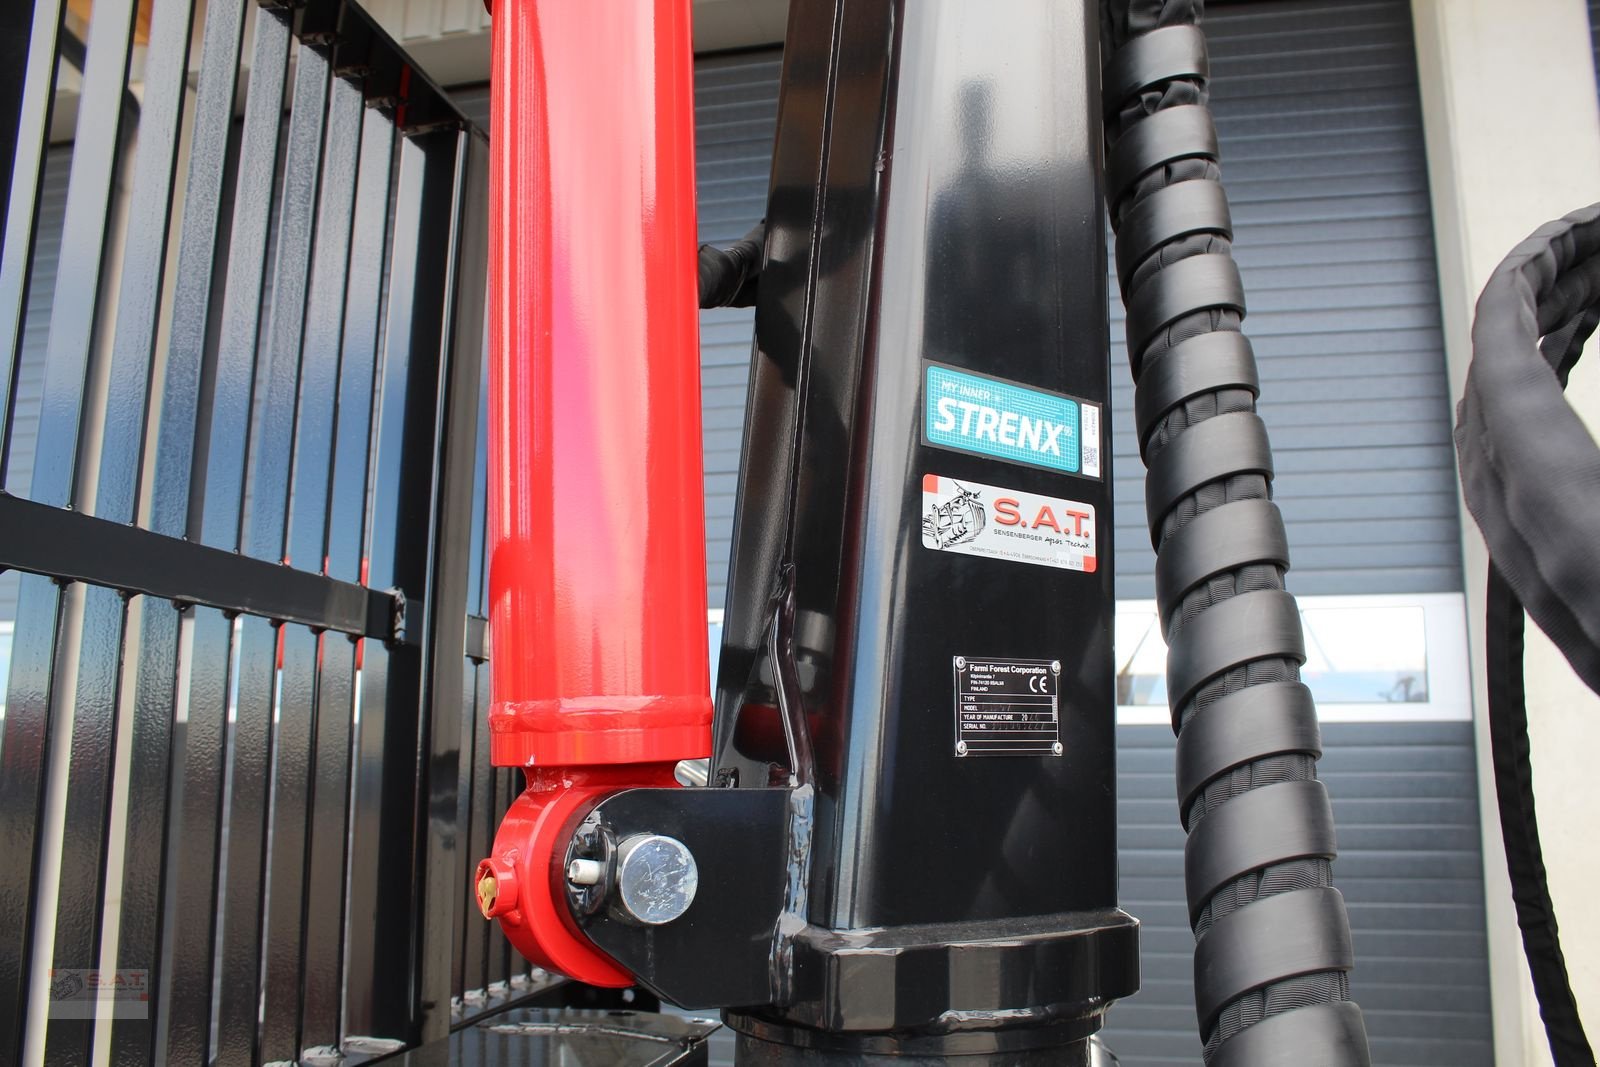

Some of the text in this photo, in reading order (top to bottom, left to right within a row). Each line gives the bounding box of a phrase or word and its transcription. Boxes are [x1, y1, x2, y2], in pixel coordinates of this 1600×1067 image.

[941, 380, 991, 402] MY INNER
[993, 497, 1090, 539] S.A.T.
[993, 528, 1043, 542] SENSENBERGER
[1065, 539, 1090, 549] Technik
[969, 664, 1047, 675] Farmi Forest Corporation
